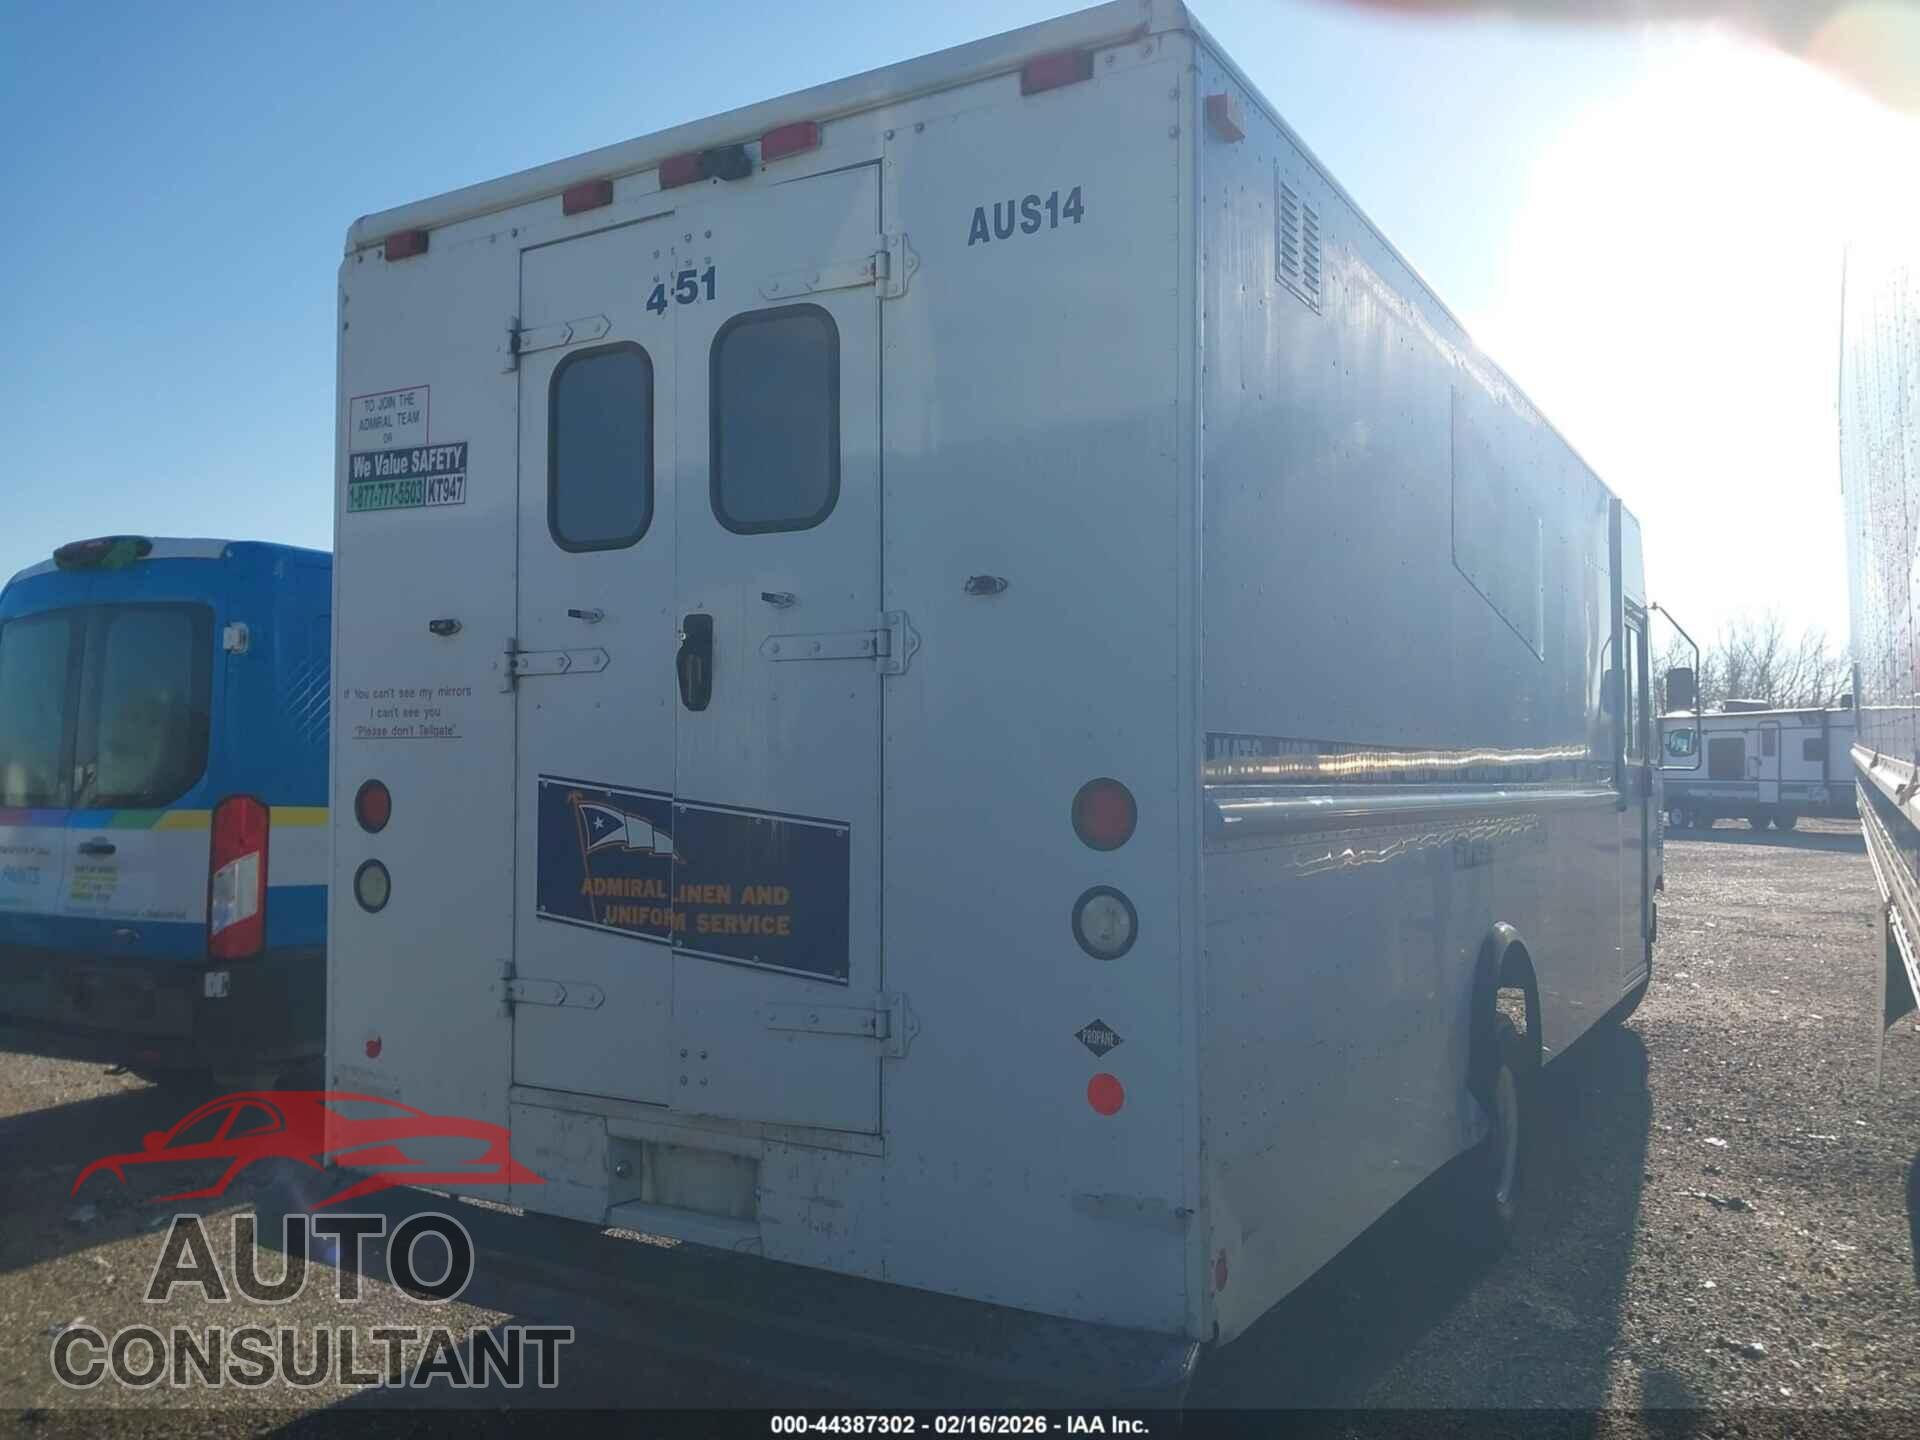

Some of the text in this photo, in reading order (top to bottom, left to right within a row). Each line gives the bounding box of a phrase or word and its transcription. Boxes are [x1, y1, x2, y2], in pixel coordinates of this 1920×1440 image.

[967, 185, 1086, 247] AUS14
[646, 265, 717, 315] 451
[364, 392, 415, 412] TO JOIN THE
[359, 410, 420, 432] ADMIRAL TEAM
[353, 446, 463, 478] We Value SAFETY
[427, 475, 464, 504] KT947
[373, 688, 395, 698] can't
[399, 688, 415, 698] see
[419, 687, 433, 700] my
[438, 685, 472, 697] mirrors
[377, 707, 399, 718] can't
[403, 708, 420, 718] see
[424, 707, 441, 720] you
[581, 877, 791, 906] ADMIRAL INEN AND
[696, 913, 792, 936] SERVICE
[1081, 1029, 1115, 1048] PROPANE
